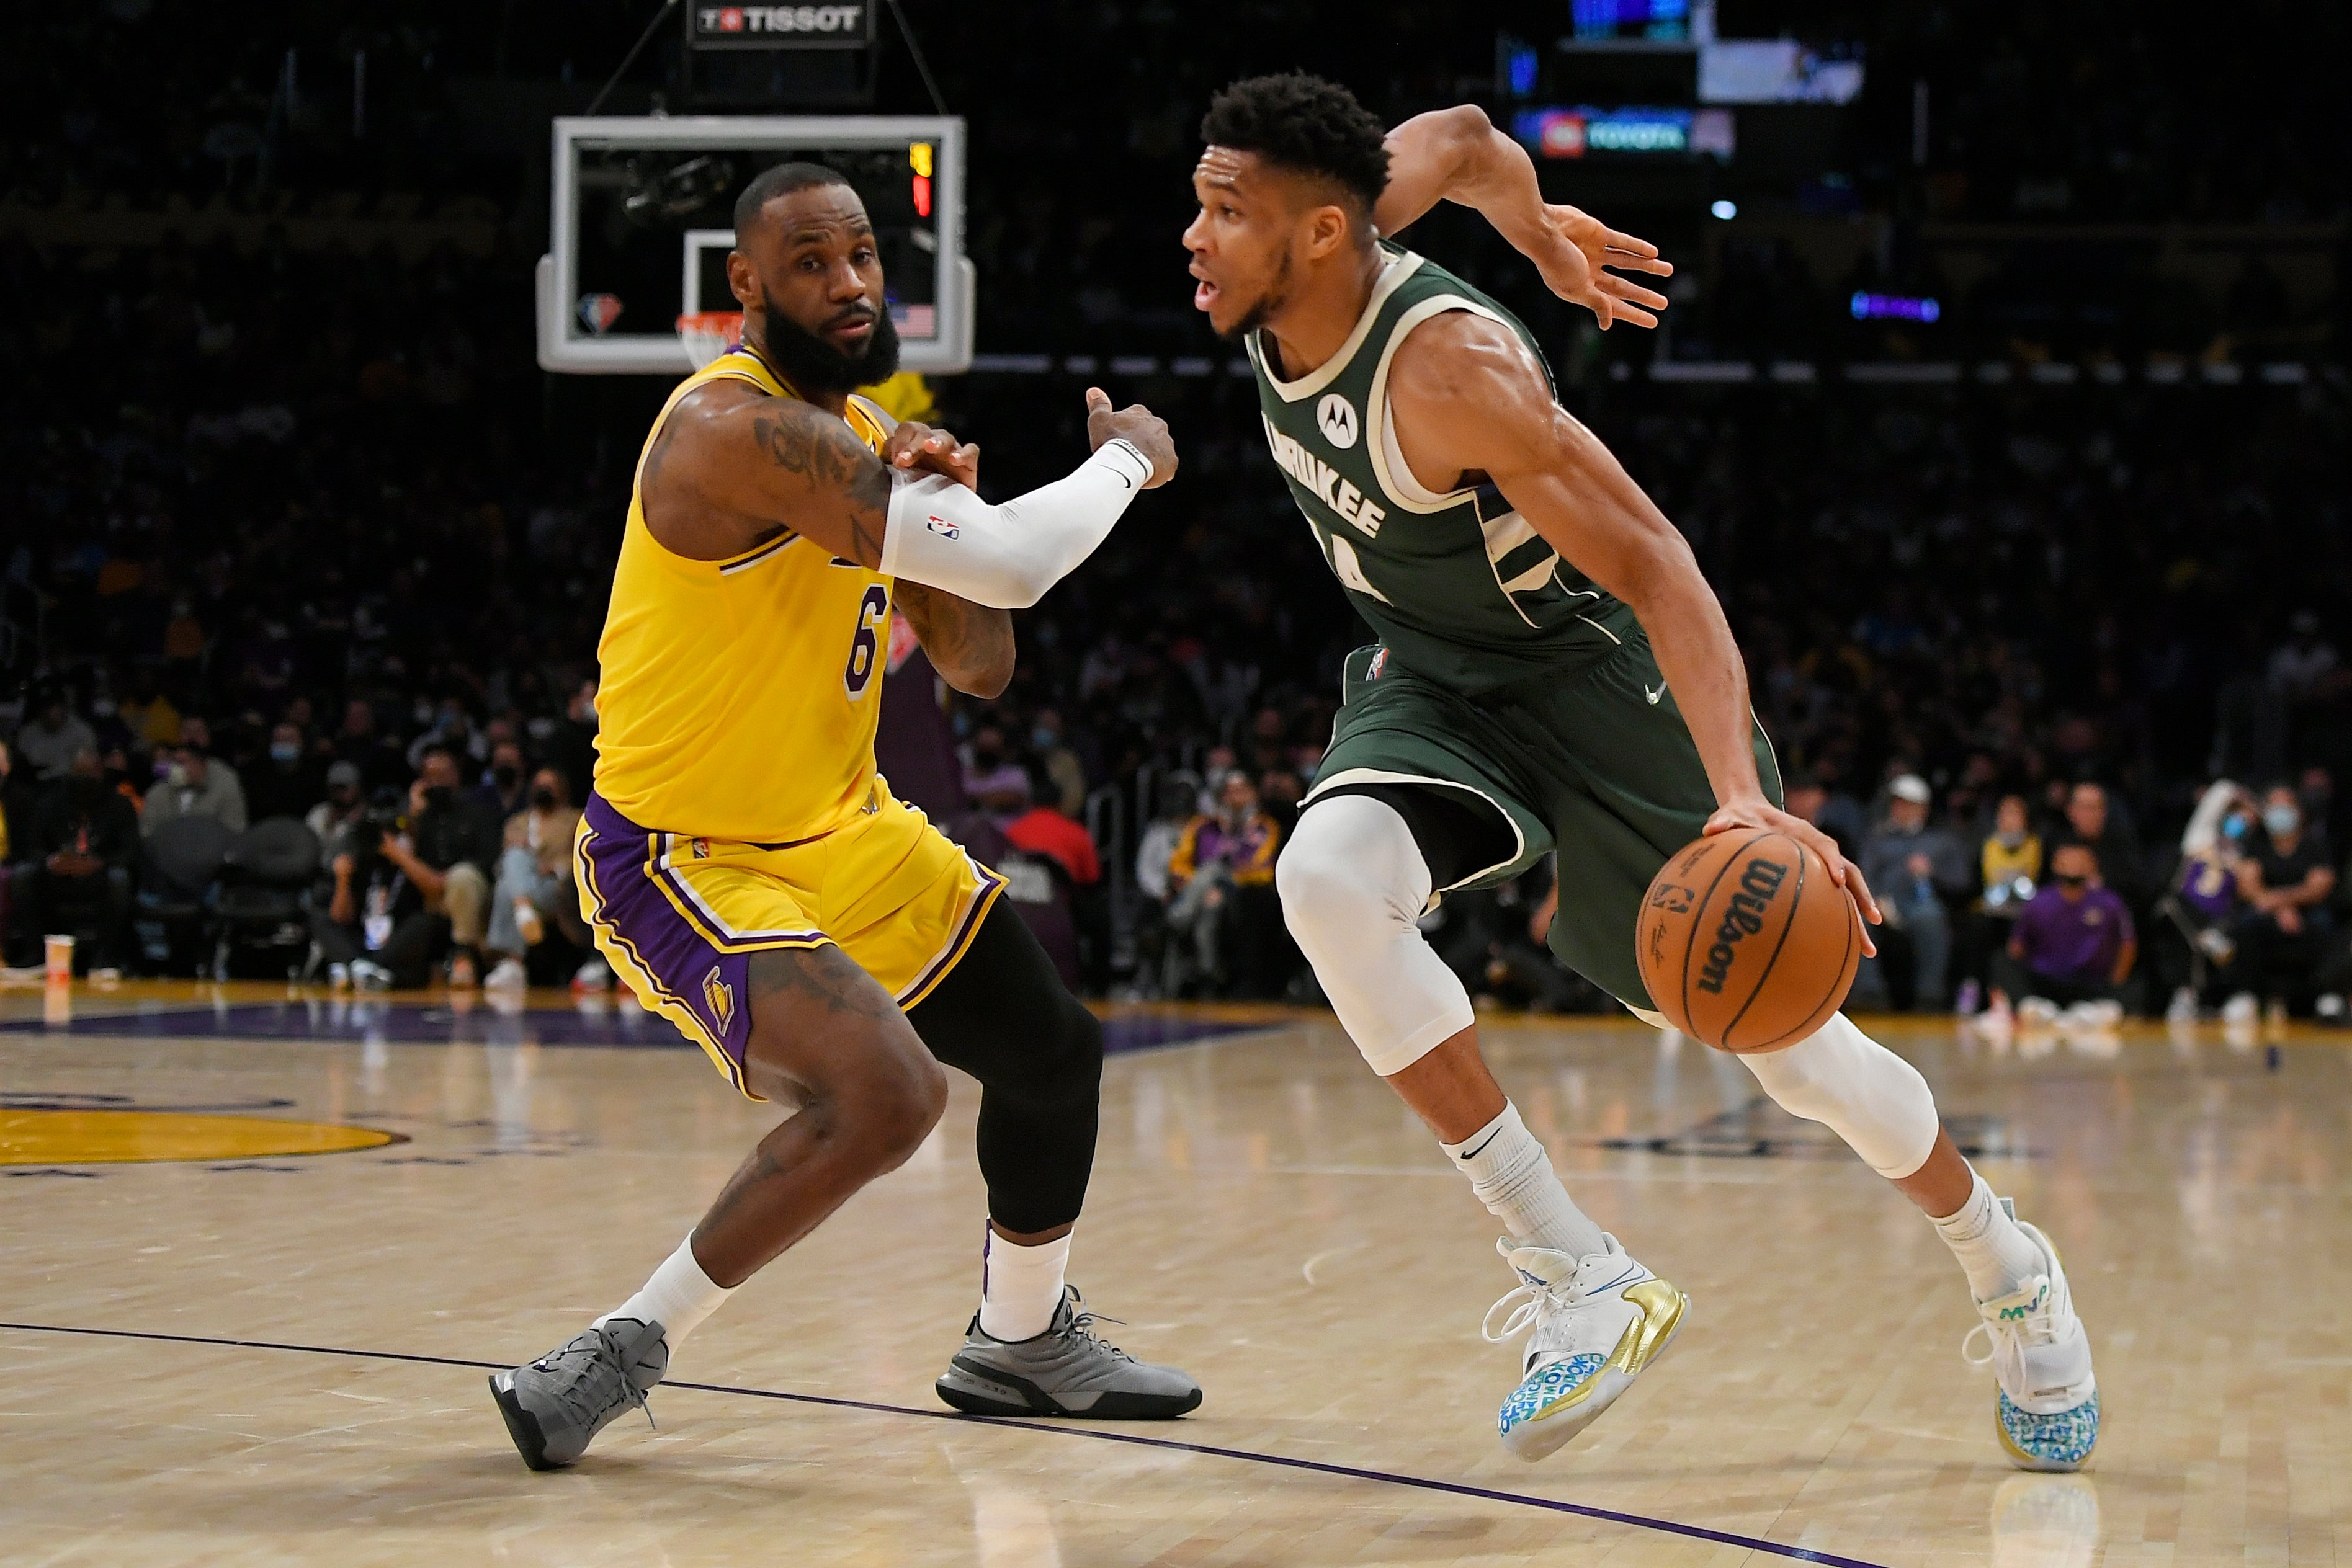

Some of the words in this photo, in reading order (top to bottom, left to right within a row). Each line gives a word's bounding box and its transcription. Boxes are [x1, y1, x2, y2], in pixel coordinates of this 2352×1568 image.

[744, 6, 861, 31] TISSOT
[843, 583, 888, 702] 6
[1697, 858, 1787, 996] Wilson
[1999, 1285, 2047, 1321] MVP
